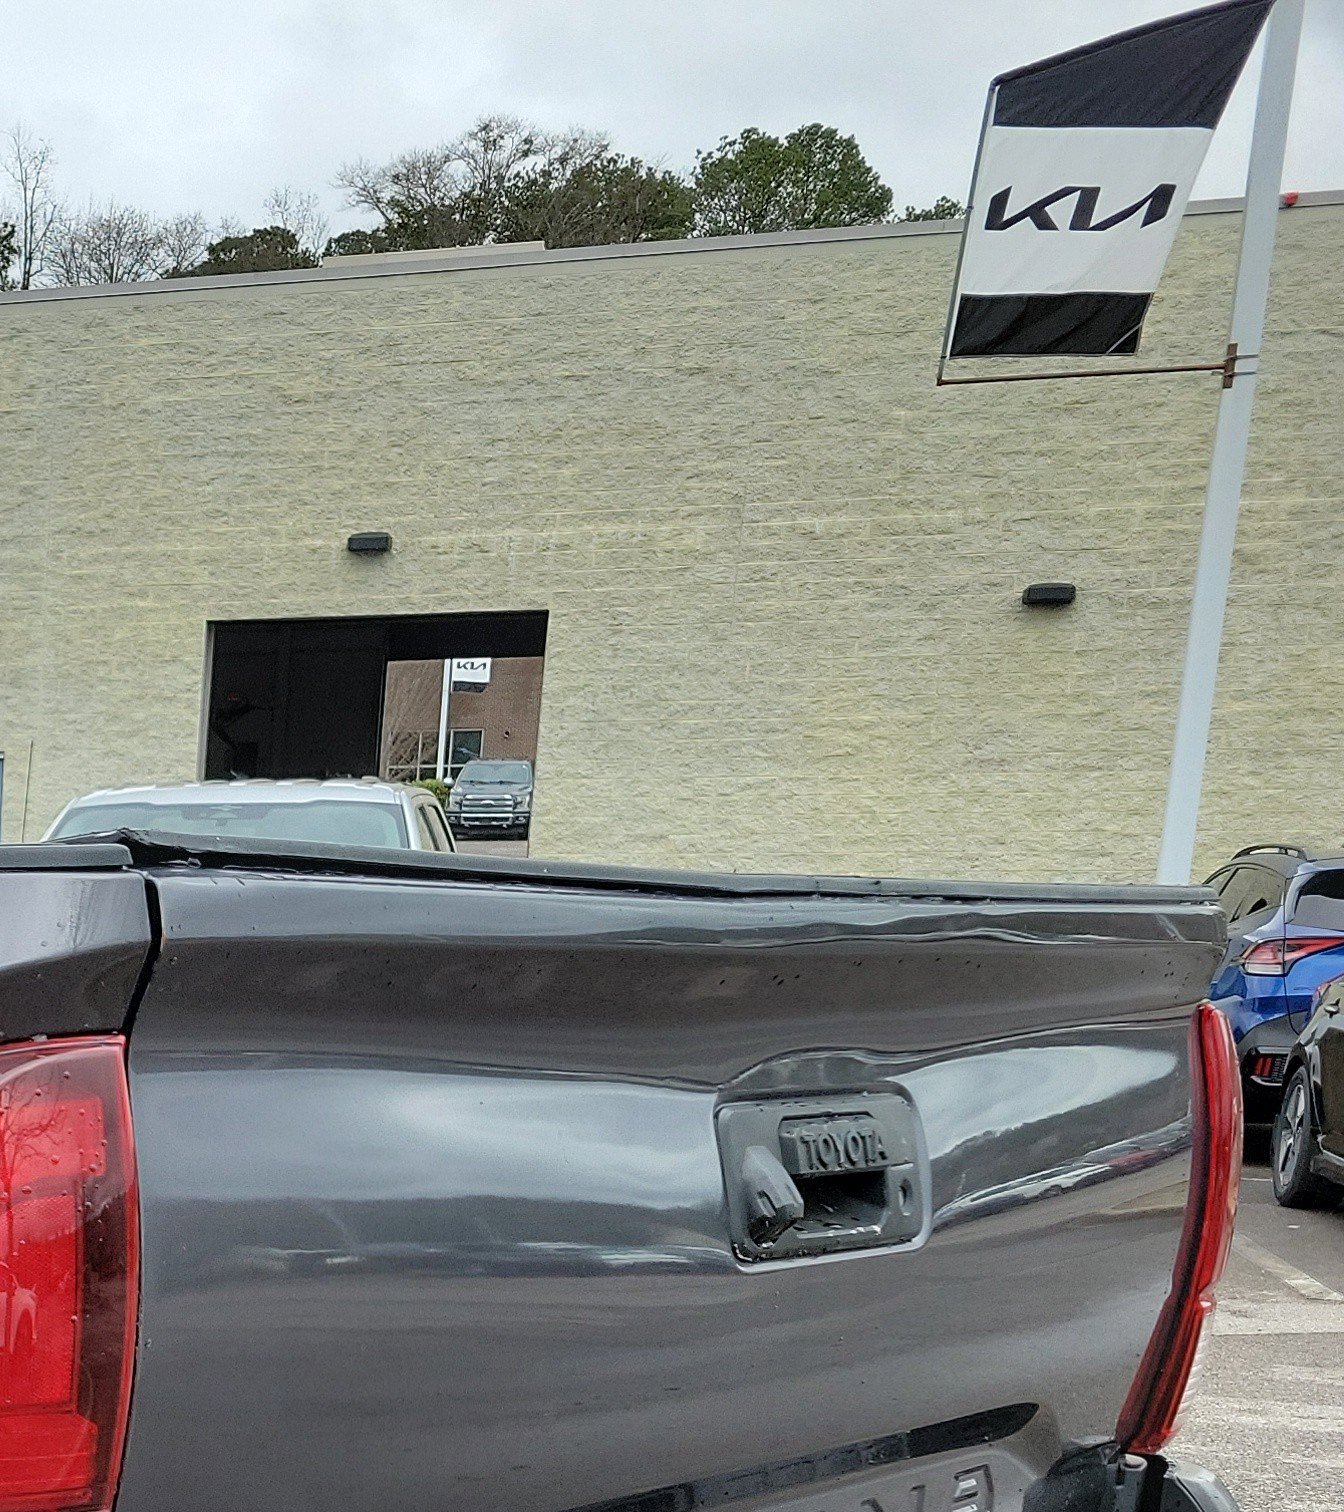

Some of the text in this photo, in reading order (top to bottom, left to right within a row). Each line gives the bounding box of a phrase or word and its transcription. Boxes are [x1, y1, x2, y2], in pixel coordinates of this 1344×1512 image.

[984, 183, 1177, 232] KIA
[456, 661, 487, 670] KIA
[799, 1129, 888, 1171] TOYOTA
